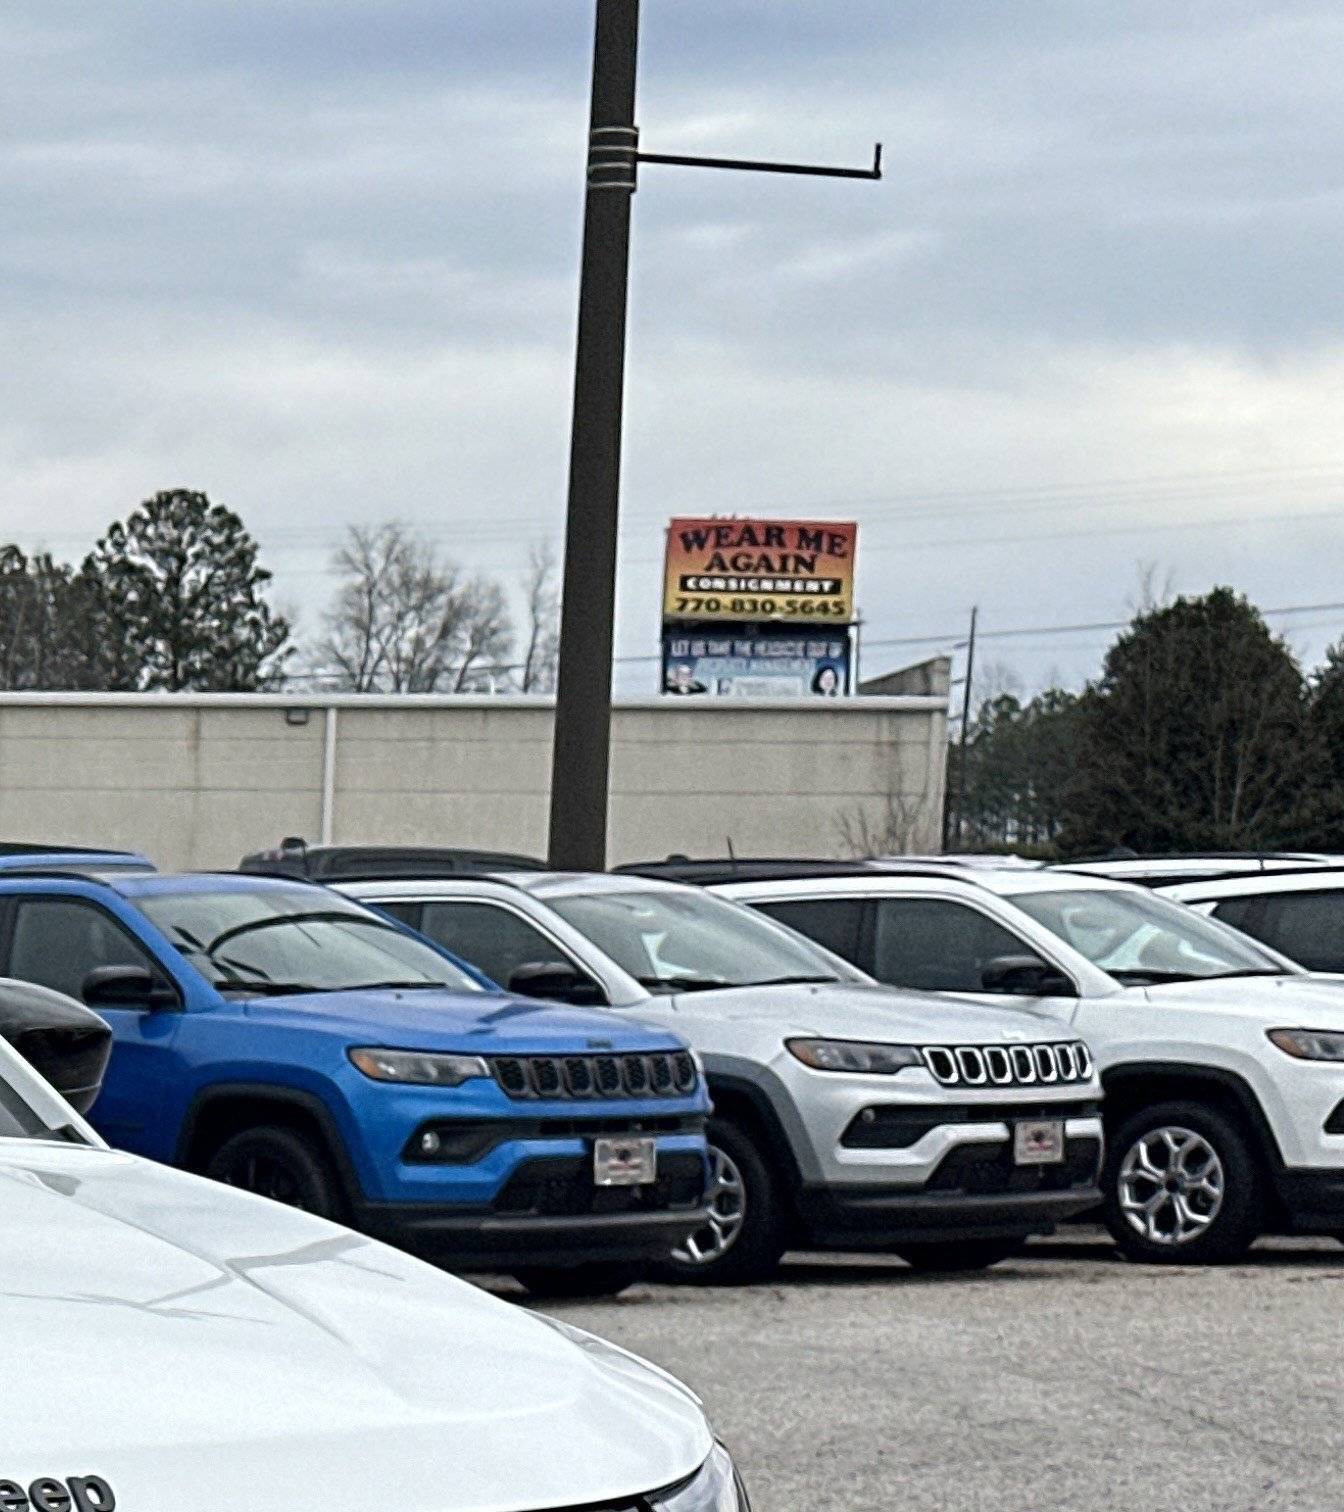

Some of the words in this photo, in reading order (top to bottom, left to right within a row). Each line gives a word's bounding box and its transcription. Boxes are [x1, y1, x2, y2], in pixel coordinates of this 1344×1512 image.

[679, 524, 786, 554] WEAR
[797, 528, 849, 558] ME
[704, 553, 817, 575] AGAIN
[685, 577, 834, 593] CONSIGNMENT
[675, 597, 846, 616] 770-830-5645
